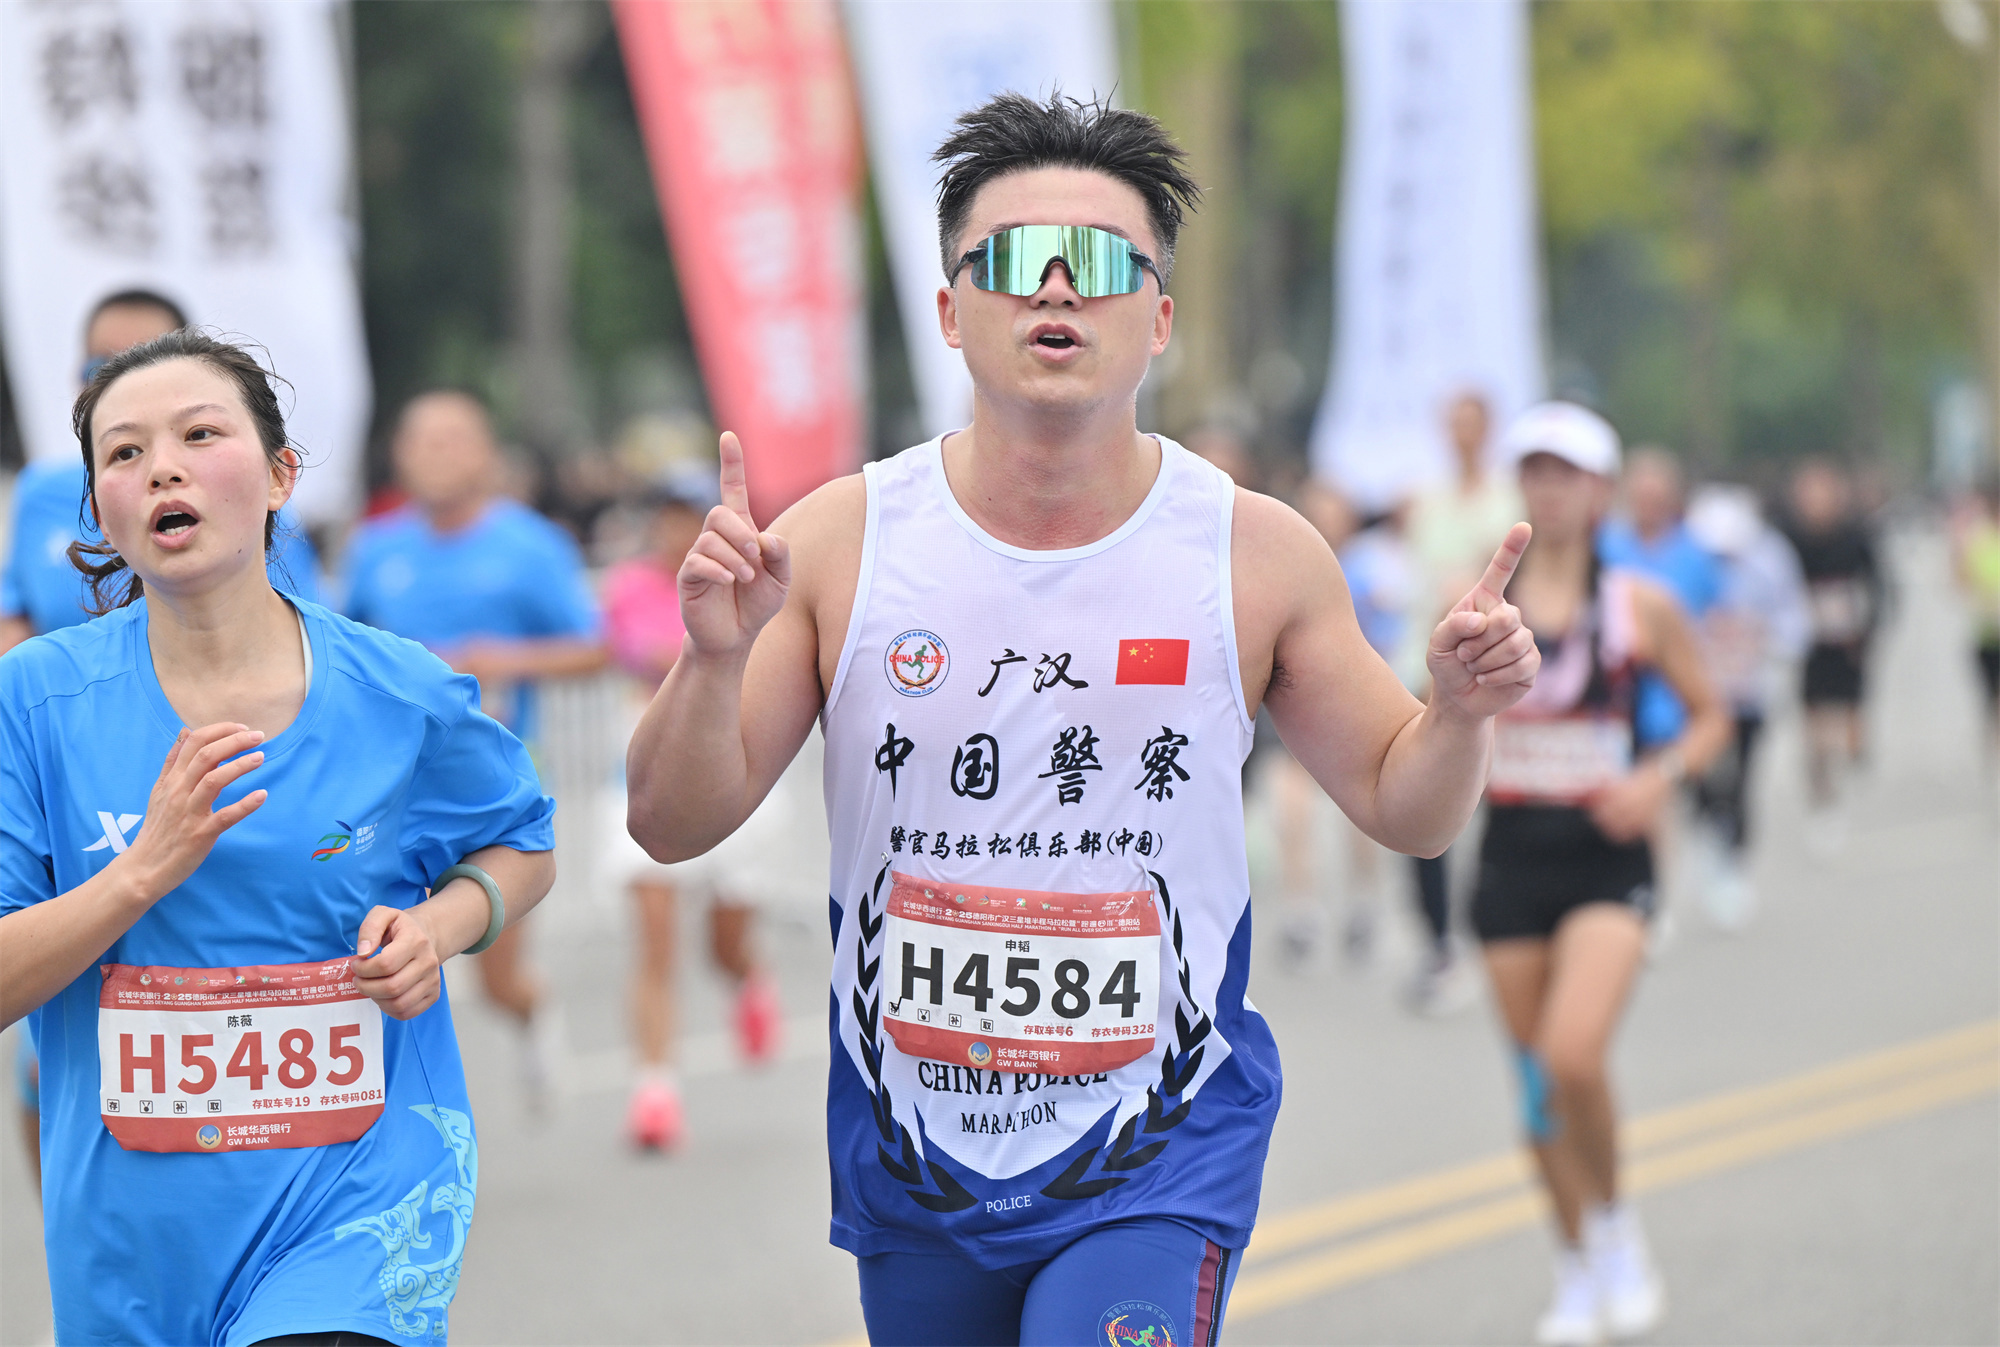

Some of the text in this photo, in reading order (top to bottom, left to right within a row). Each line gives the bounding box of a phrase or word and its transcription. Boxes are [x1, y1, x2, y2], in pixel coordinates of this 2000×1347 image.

[889, 654, 945, 664] CHINA POLICE
[977, 648, 1088, 697] 广汉
[875, 723, 1190, 806] 中国警察
[890, 825, 1163, 859] 警官马拉松俱乐部(中国)
[1005, 939, 1030, 953] 申韬
[902, 941, 1141, 1019] H4584
[227, 1014, 252, 1028] 陈薇
[1023, 1024, 1154, 1037] 存取车号6 存衣号码328
[119, 1023, 364, 1095] H5485
[996, 1059, 1011, 1067] GW
[997, 1047, 1061, 1061] 长城华西银行
[918, 1060, 1003, 1095] CHINA
[252, 1089, 383, 1109] 存取车号19 存衣号码081
[227, 1123, 291, 1137] 长城华西银行
[227, 1138, 242, 1146] GW
[985, 1194, 1032, 1213] POLICE
[1104, 1322, 1139, 1341] CHINA
